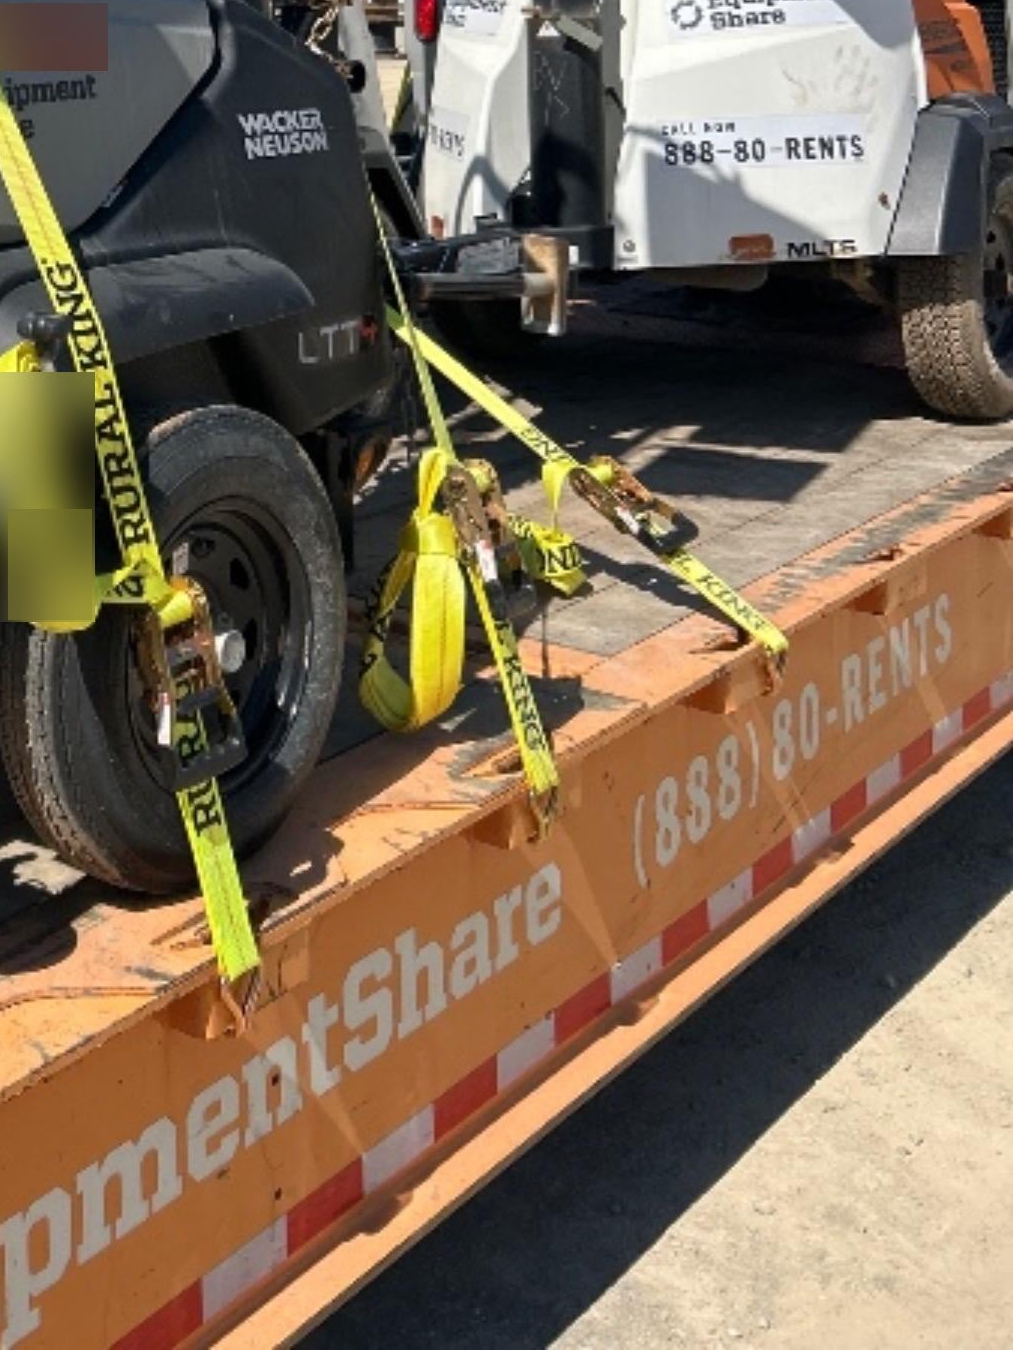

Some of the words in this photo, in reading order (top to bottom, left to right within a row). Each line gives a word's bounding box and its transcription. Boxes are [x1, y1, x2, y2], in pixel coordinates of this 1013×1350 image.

[708, 9, 787, 30] Share
[238, 107, 325, 137] WACKER
[243, 132, 330, 160] NEUSON
[95, 383, 150, 548] RURAL
